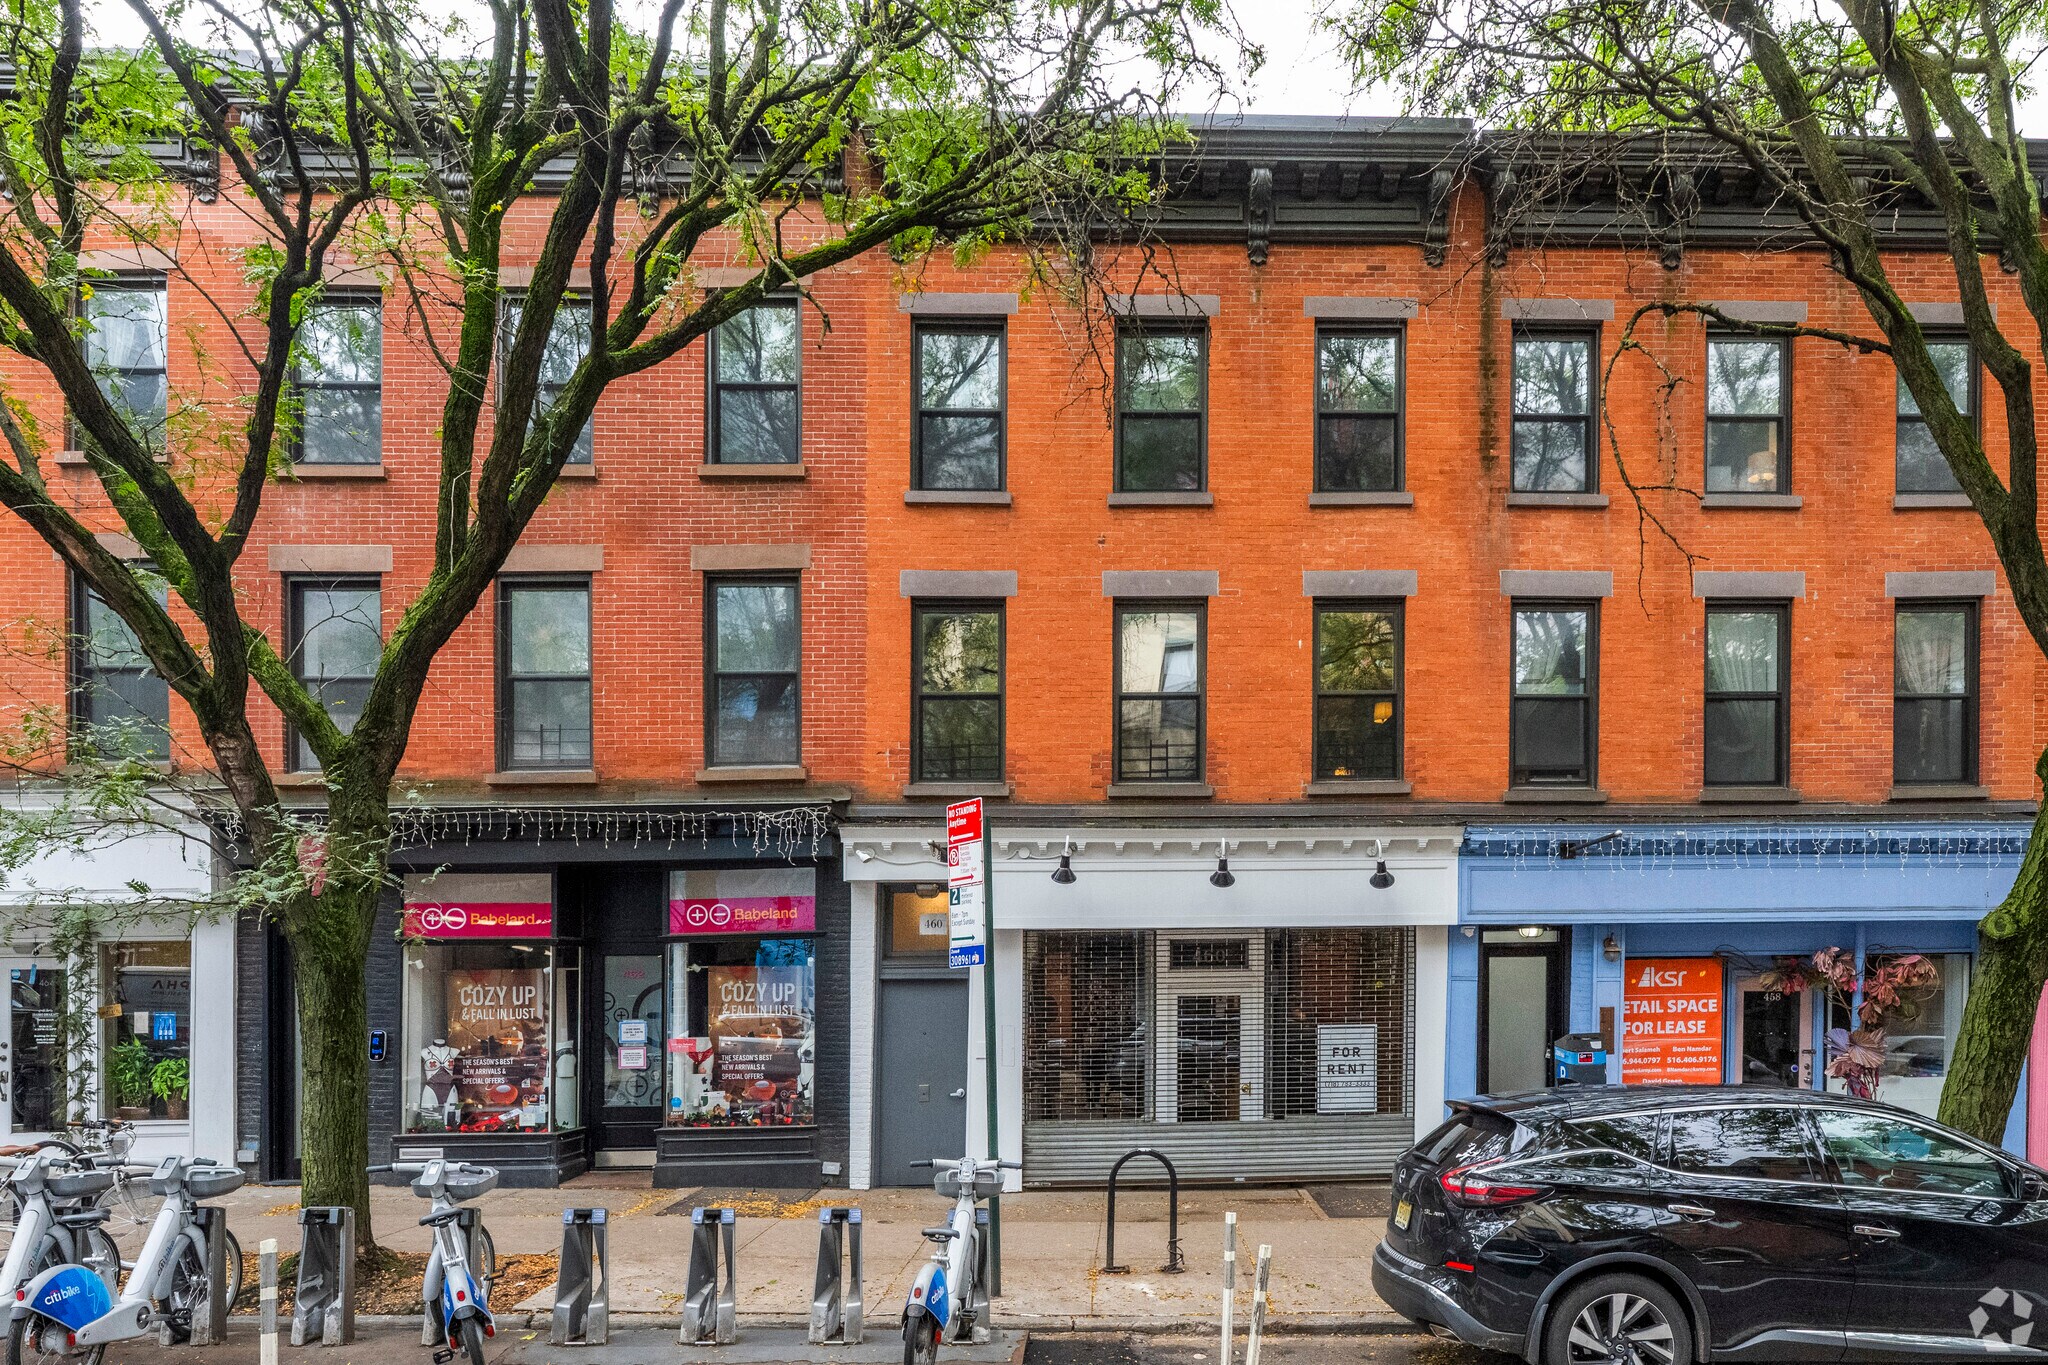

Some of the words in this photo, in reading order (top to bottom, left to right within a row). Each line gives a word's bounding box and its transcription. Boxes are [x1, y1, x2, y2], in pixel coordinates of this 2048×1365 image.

[949, 809, 955, 818] NO
[955, 804, 977, 817] STANDING
[949, 818, 967, 828] Anytime
[952, 889, 958, 904] 2
[470, 913, 535, 925] Babeland
[734, 907, 798, 920] Babeland
[925, 919, 943, 929] 460
[951, 954, 971, 966] 308961
[460, 985, 507, 1006] COZY
[512, 985, 536, 1006] UP
[721, 982, 767, 1002] COZY
[772, 982, 796, 1003] UP
[1763, 992, 1781, 1001] 458
[722, 1004, 730, 1014] &
[769, 1004, 795, 1016] LUST
[1624, 1000, 1664, 1014] ETAIL
[1667, 999, 1718, 1013] SPACE
[461, 1007, 469, 1020] &
[510, 1007, 536, 1020] LUST
[1623, 1021, 1654, 1035] FOR
[1656, 1020, 1706, 1034] LEASE
[722, 1054, 732, 1062] THE
[1332, 1047, 1361, 1058] FOR
[462, 1058, 473, 1066] THE
[473, 1058, 500, 1066] SEASON'S
[1667, 1056, 1717, 1064] 516.406.9176
[1327, 1063, 1367, 1075] RENT
[462, 1077, 484, 1085] SPECIAL
[44, 1289, 62, 1305] citi
[61, 1285, 81, 1299] bike
